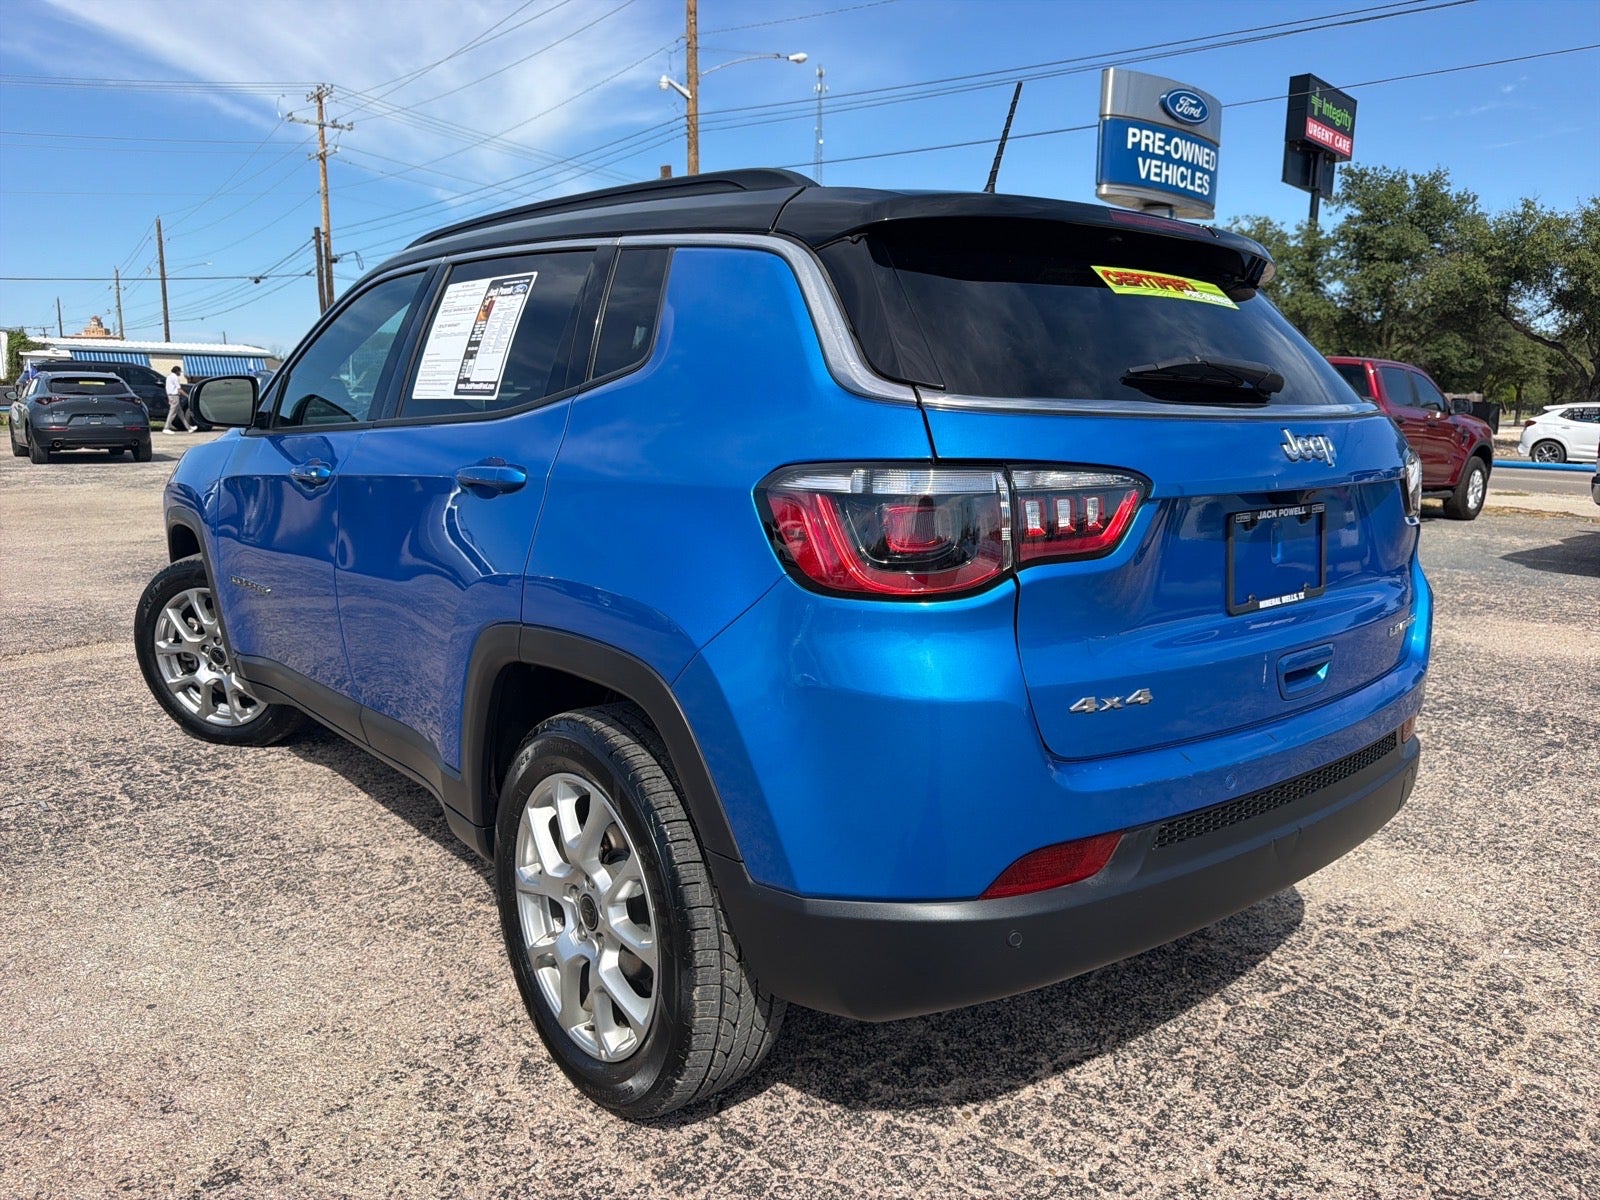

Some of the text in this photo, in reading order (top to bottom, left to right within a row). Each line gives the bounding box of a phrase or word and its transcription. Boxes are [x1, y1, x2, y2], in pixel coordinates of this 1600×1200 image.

[1175, 96, 1203, 118] Ford
[1322, 98, 1352, 131] Integrity
[1127, 127, 1216, 171] PRE-OWNED
[1308, 122, 1350, 152] URGENT CARE
[1138, 157, 1210, 195] VEHICLES
[1281, 428, 1336, 466] Jeep
[1257, 509, 1277, 520] JACK
[1279, 506, 1306, 517] POWELL
[1069, 688, 1153, 713] 4x4
